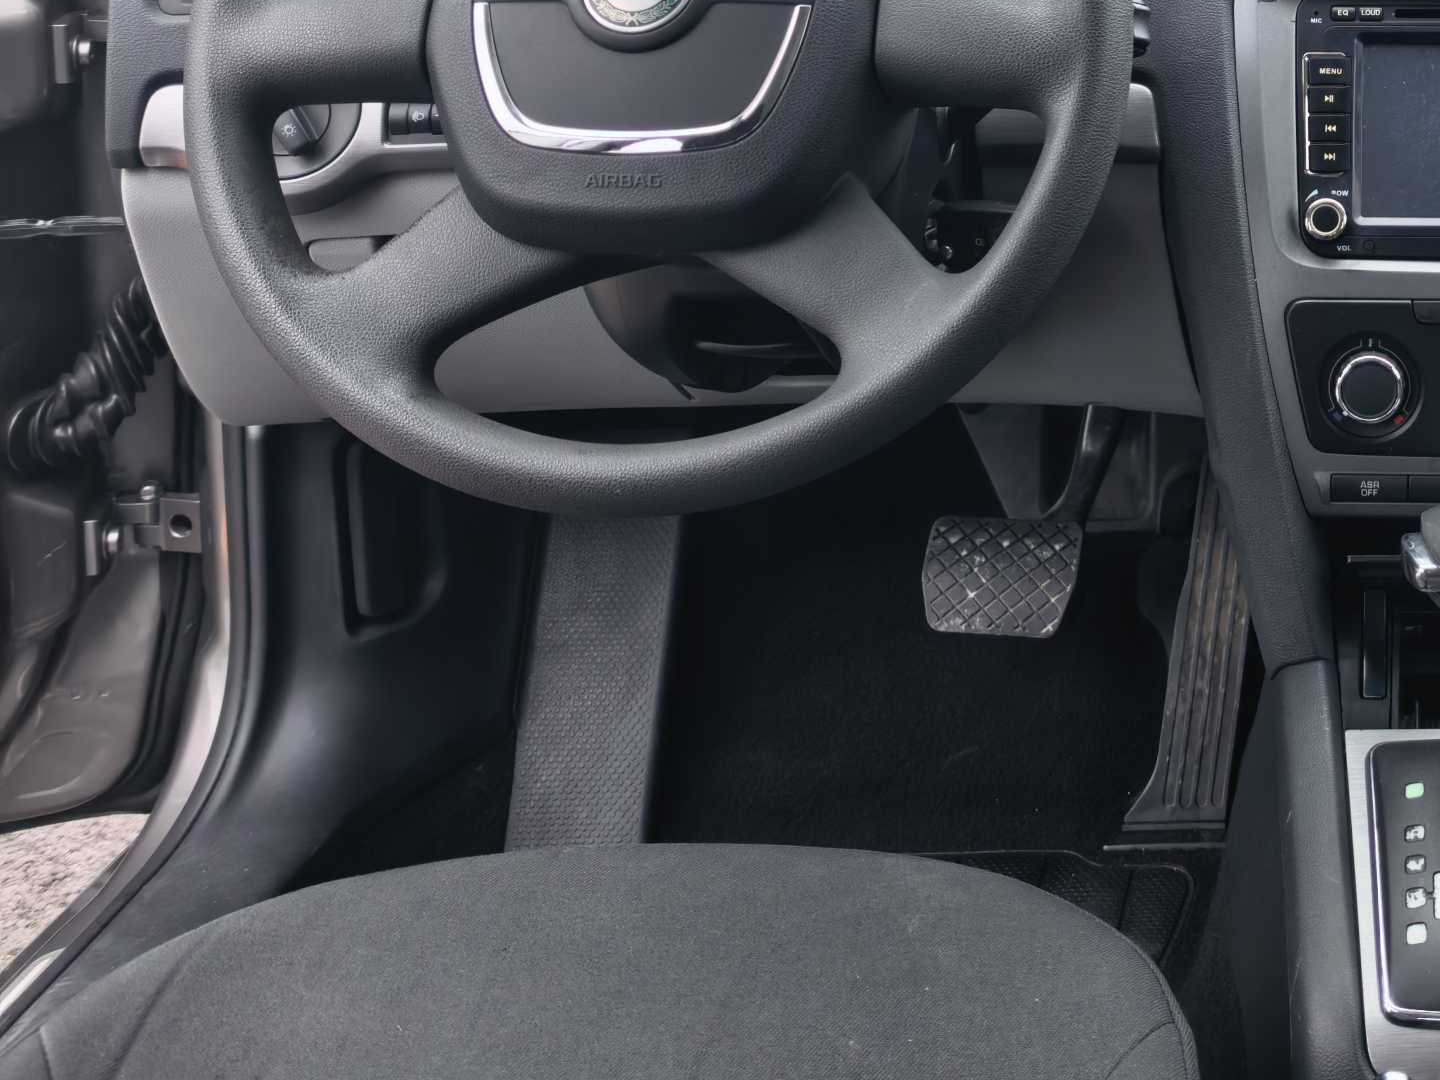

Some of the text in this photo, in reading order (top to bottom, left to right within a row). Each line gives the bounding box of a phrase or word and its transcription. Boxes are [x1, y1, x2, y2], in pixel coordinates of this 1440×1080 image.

[1319, 67, 1343, 75] MENU
[584, 172, 663, 189] AIRBAG
[1336, 244, 1352, 252] VOL
[1360, 488, 1379, 497] OFF
